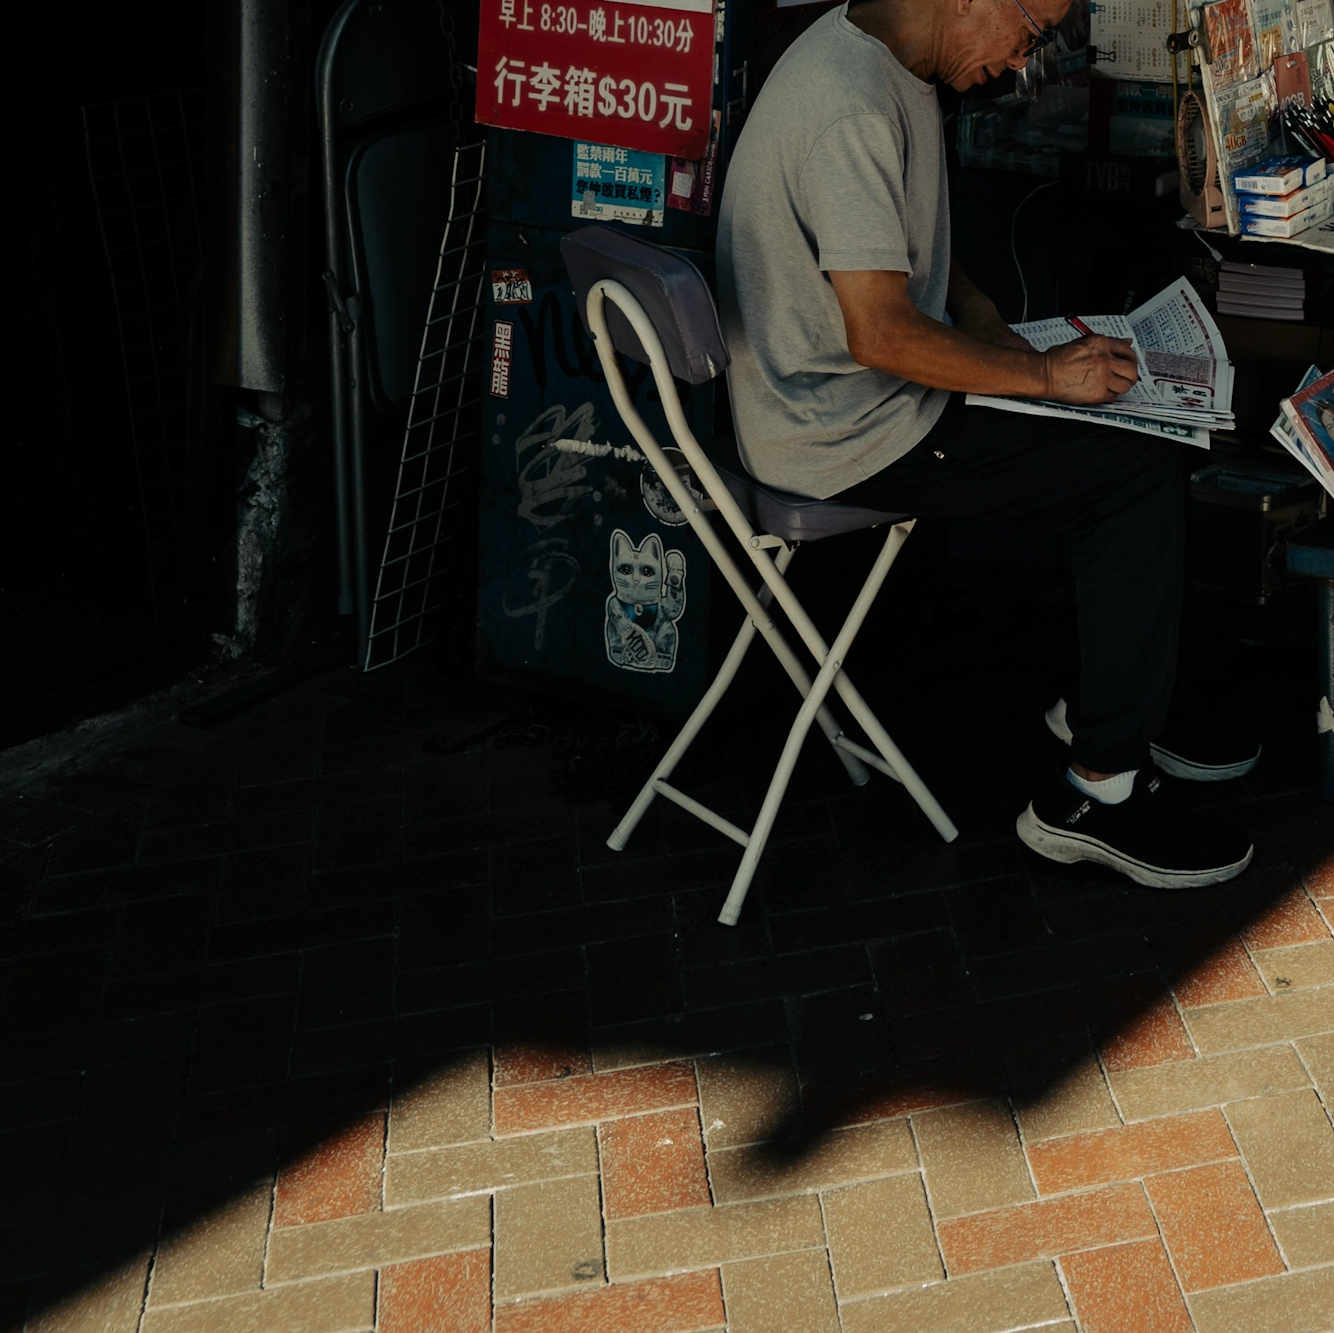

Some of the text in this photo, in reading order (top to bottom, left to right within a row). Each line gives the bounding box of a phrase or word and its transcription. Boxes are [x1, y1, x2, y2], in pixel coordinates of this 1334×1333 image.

[494, 56, 693, 131] 行李箱$30元
[1226, 134, 1247, 151] 40GB
[1085, 161, 1118, 191] TVB
